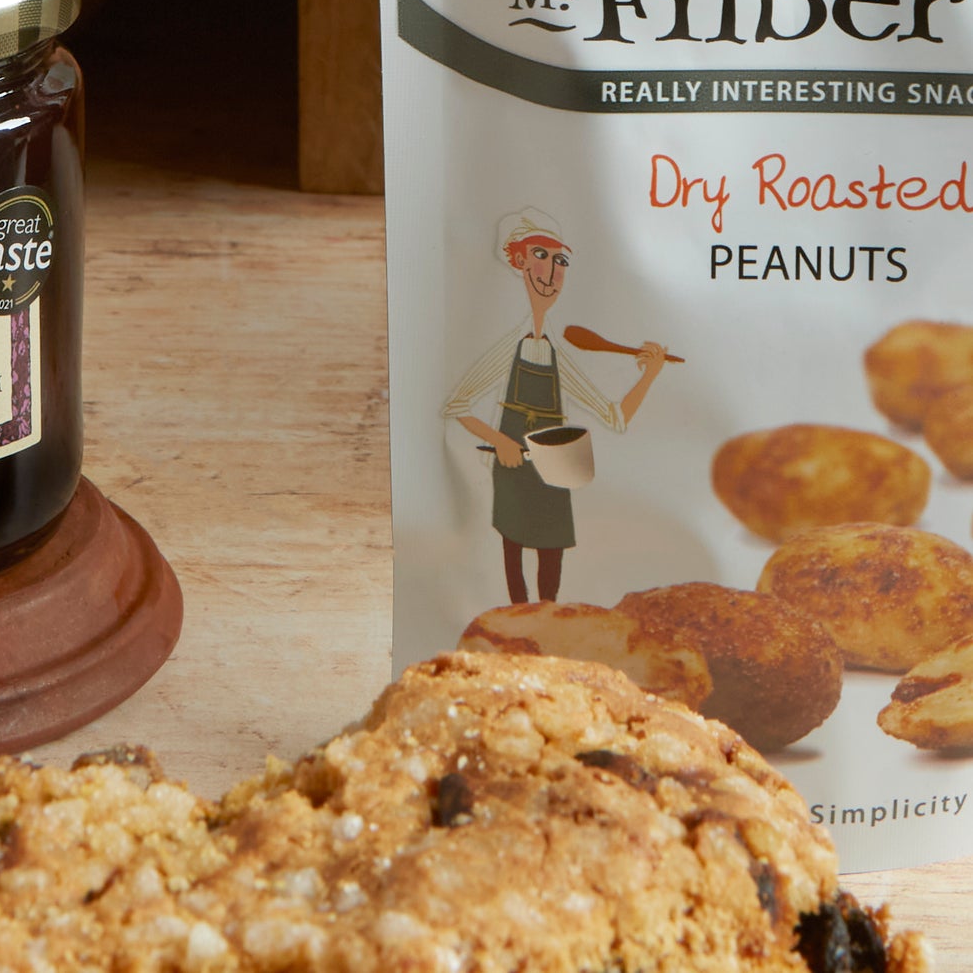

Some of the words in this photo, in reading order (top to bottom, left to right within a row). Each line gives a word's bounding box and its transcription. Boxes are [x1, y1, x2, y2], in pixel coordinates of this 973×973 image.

[601, 81, 699, 104] REALLY
[712, 80, 896, 104] INTERESTING
[649, 154, 729, 233] Dry
[752, 153, 973, 213] Roasted
[710, 245, 907, 283] PEANUTS
[810, 793, 968, 827] Simplicity
